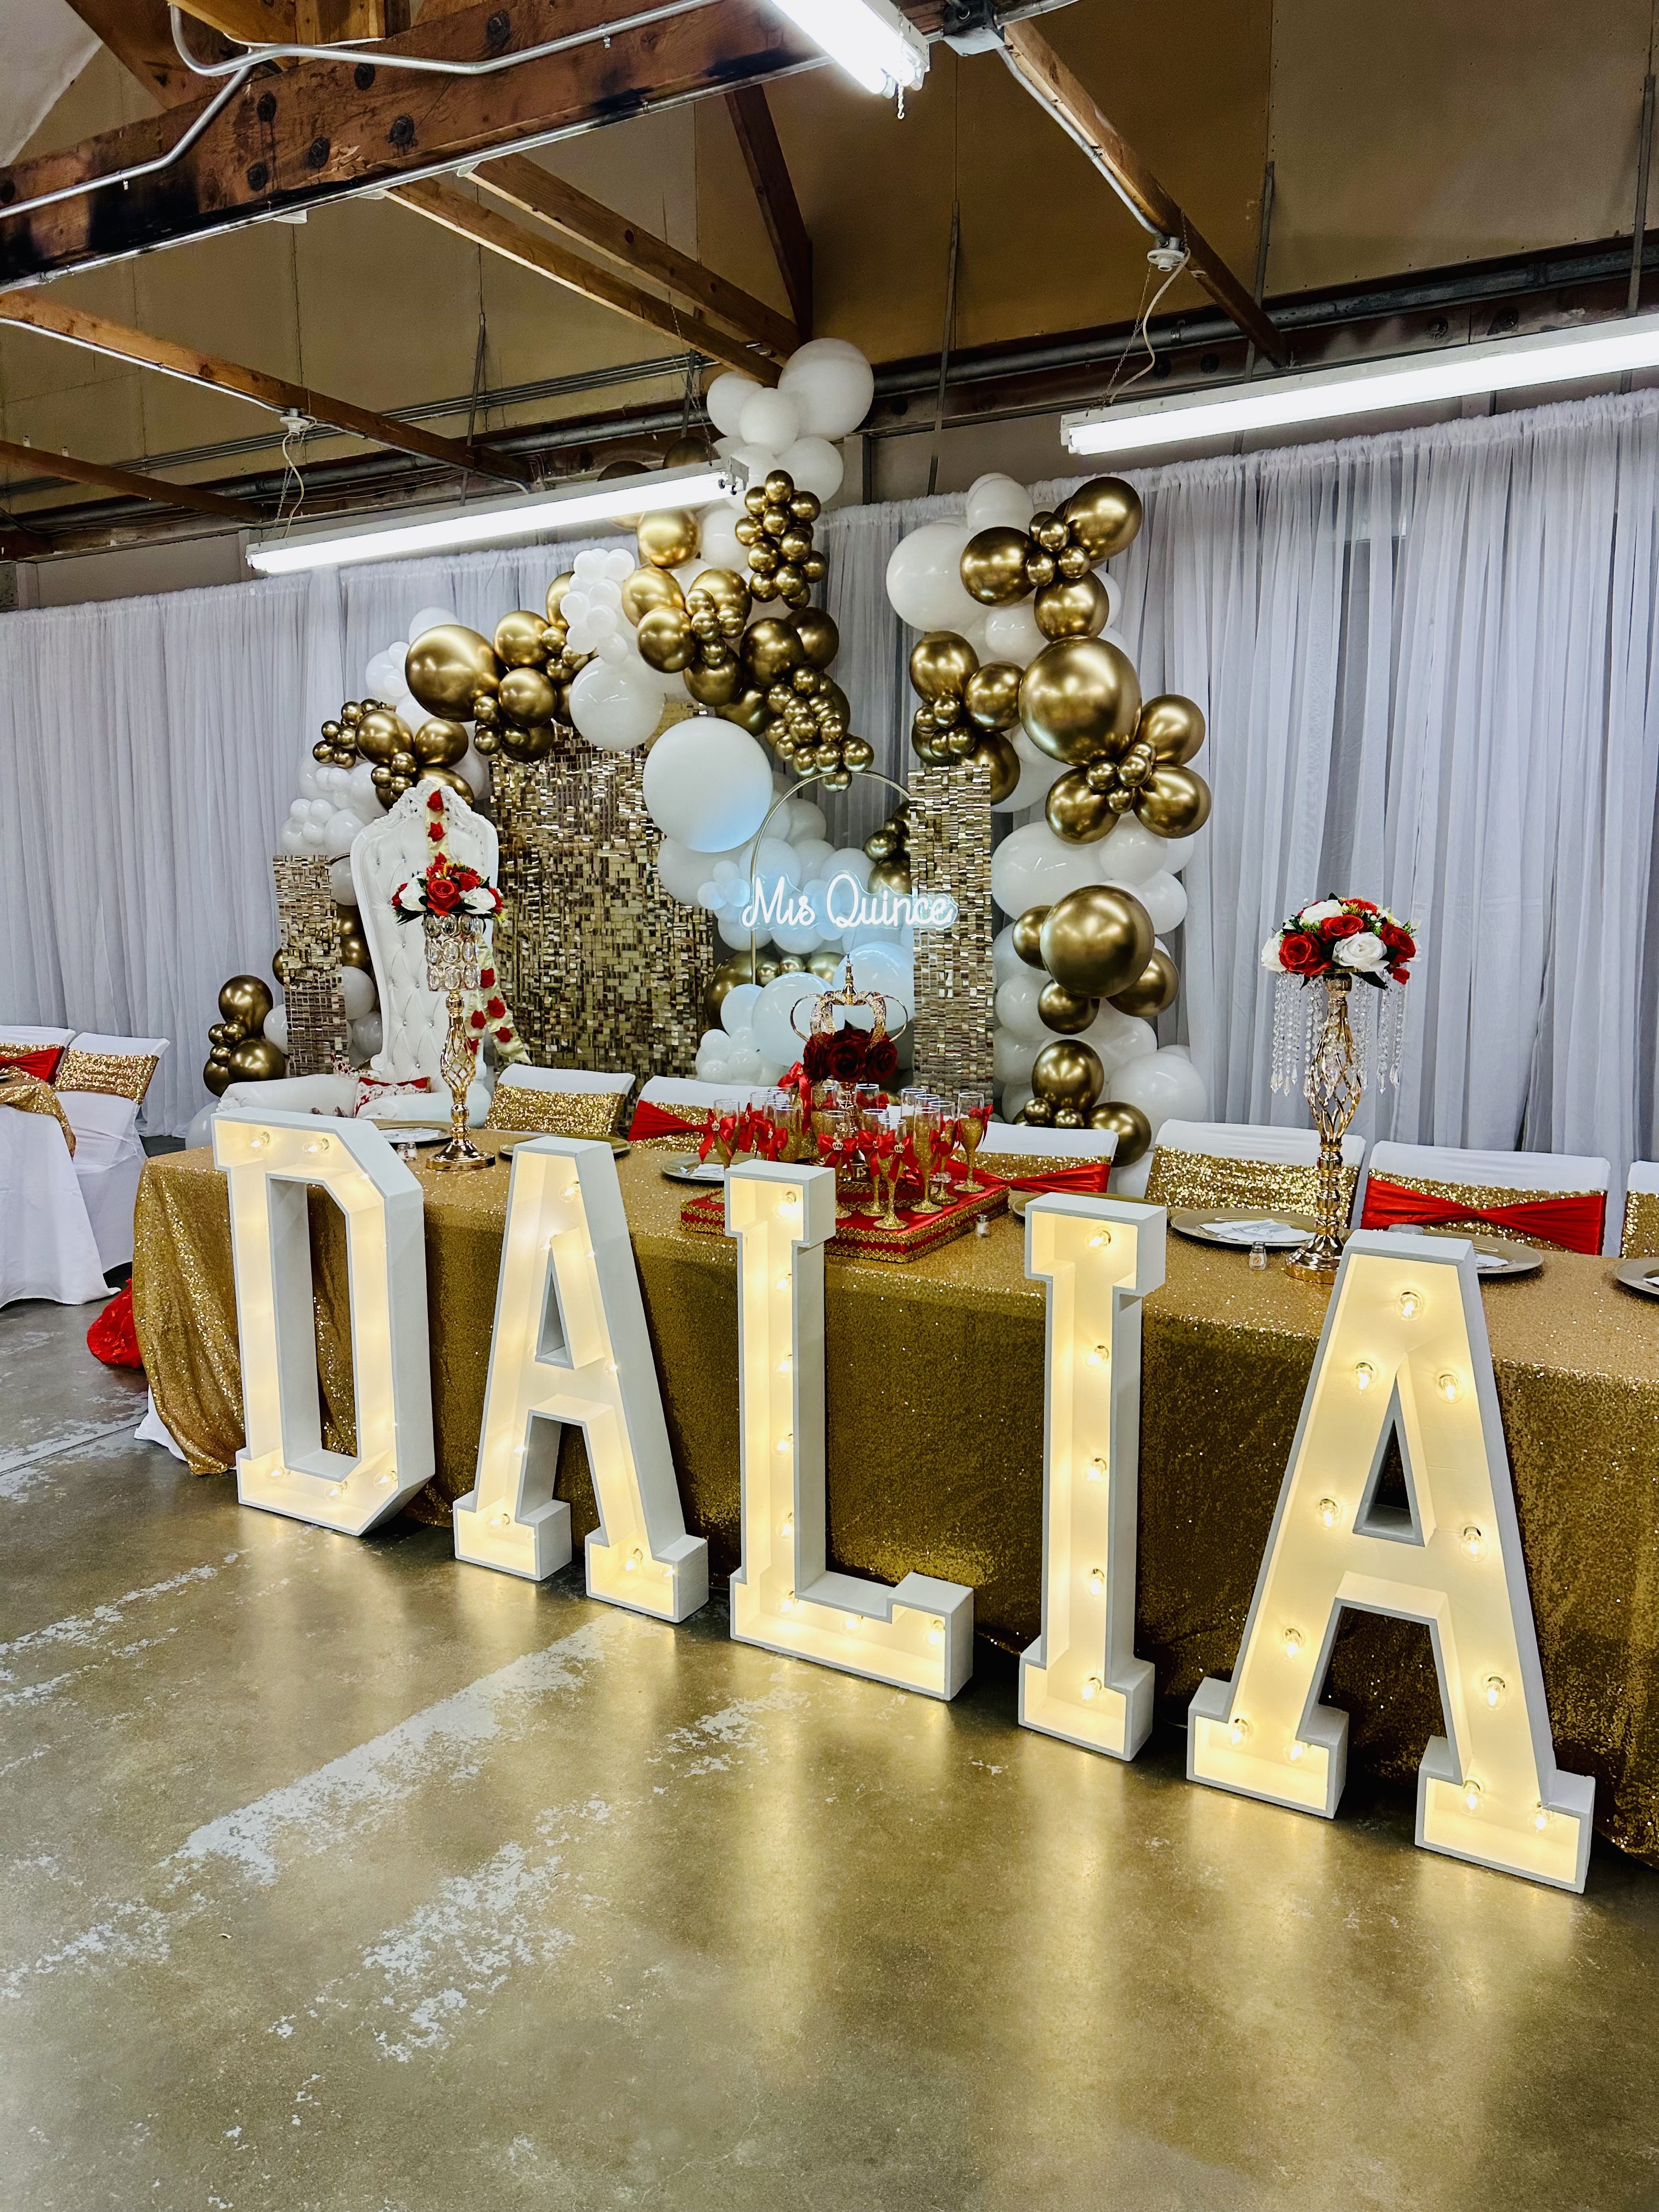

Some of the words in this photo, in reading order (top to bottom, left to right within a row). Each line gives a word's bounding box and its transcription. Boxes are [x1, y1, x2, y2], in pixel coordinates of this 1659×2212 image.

[742, 874, 816, 927] Mis
[826, 873, 953, 928] Quince
[212, 1107, 1596, 1894] DALIA
